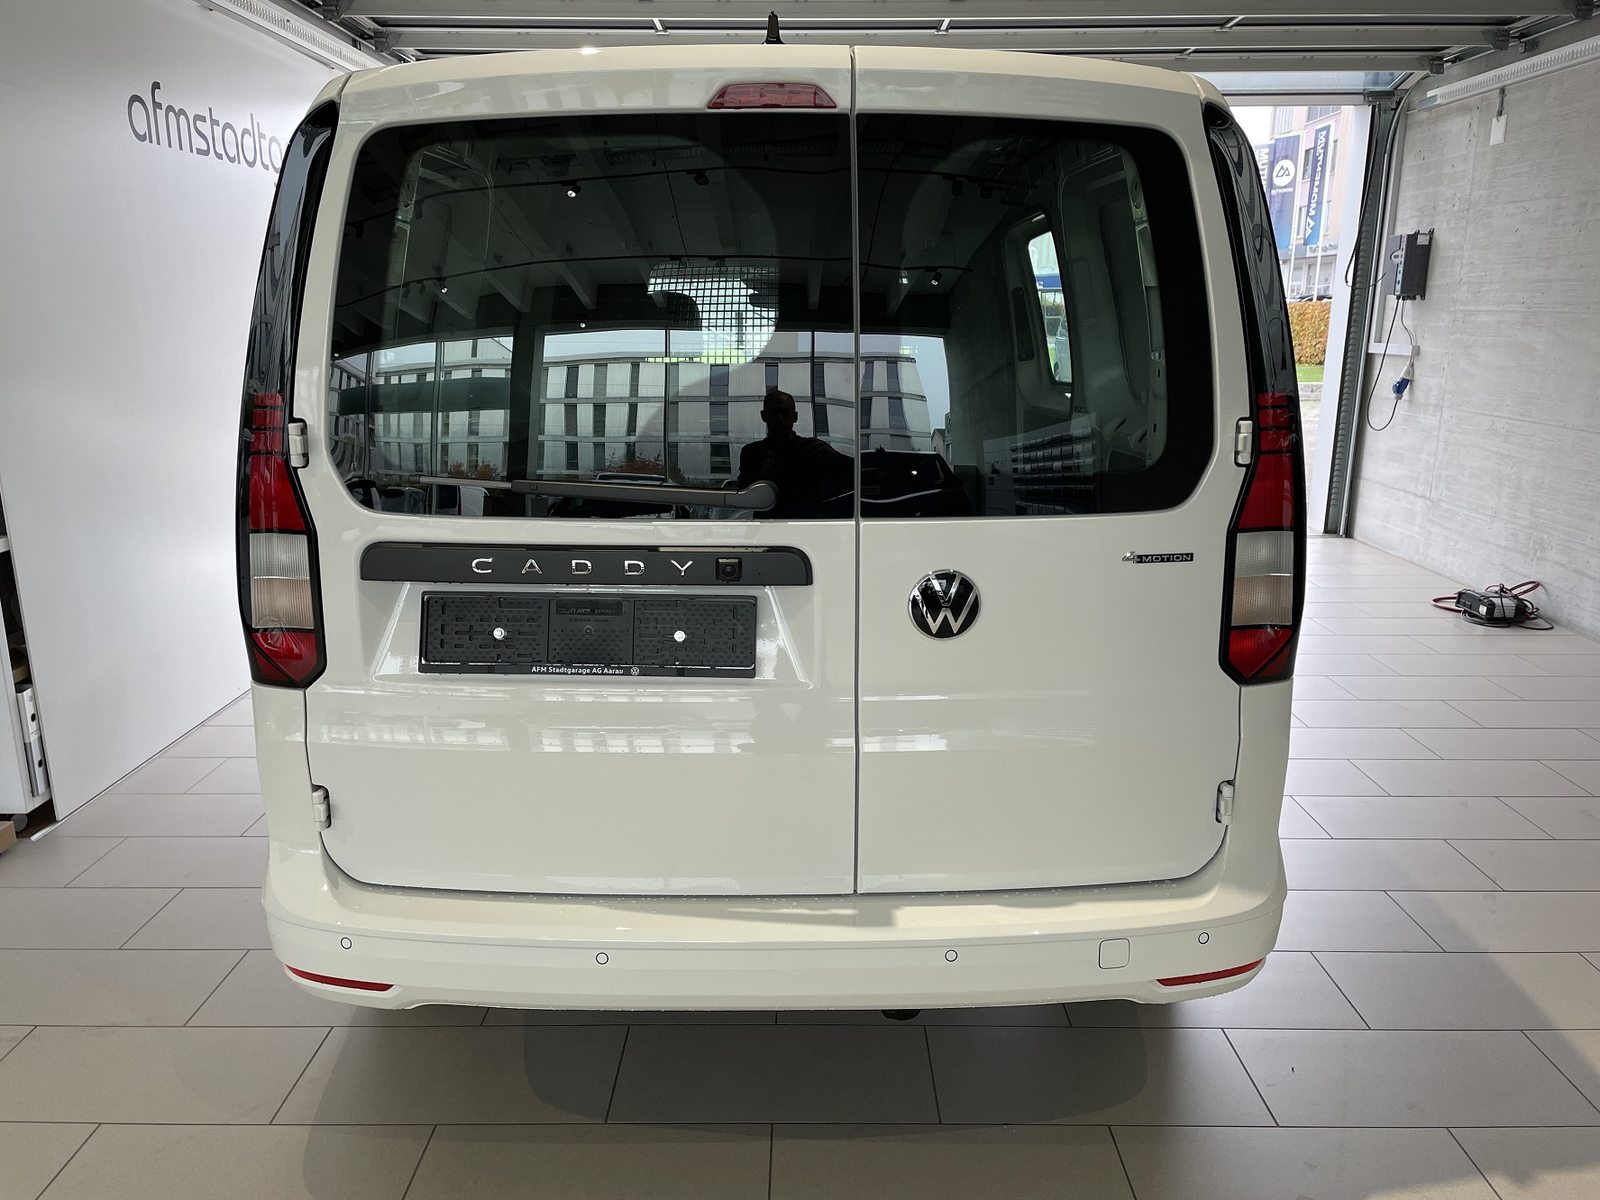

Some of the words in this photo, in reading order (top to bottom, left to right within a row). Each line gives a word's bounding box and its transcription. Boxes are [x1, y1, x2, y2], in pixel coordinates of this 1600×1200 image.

[1121, 551, 1192, 564] 4MOTION
[471, 557, 694, 576] CADDY
[548, 666, 591, 675] Stadtgarage
